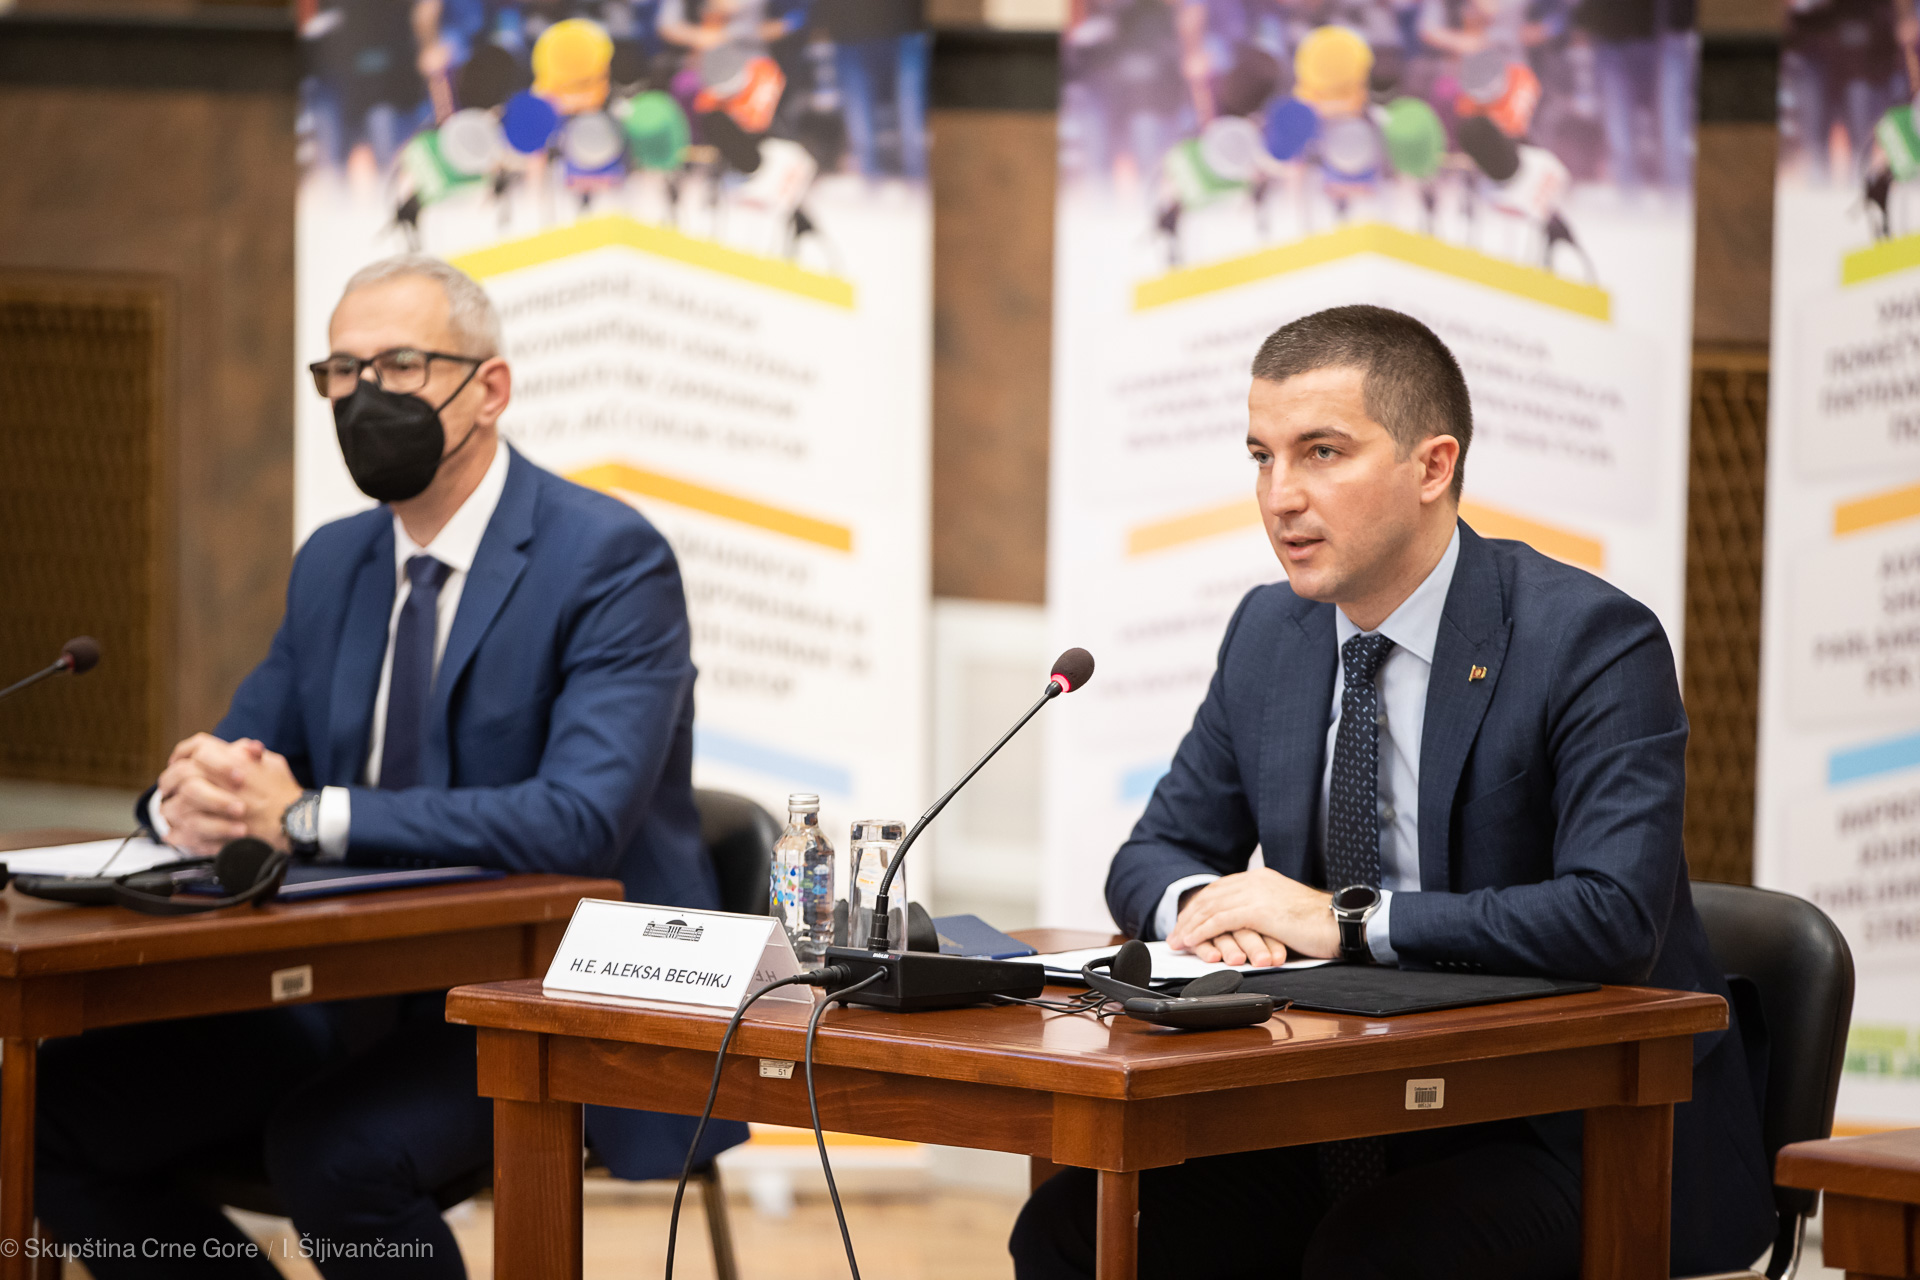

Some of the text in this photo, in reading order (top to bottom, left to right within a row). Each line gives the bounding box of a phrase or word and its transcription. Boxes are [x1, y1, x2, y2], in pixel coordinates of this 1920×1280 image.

[570, 958, 732, 989] H.E. ALEKSA BECHIKJ
